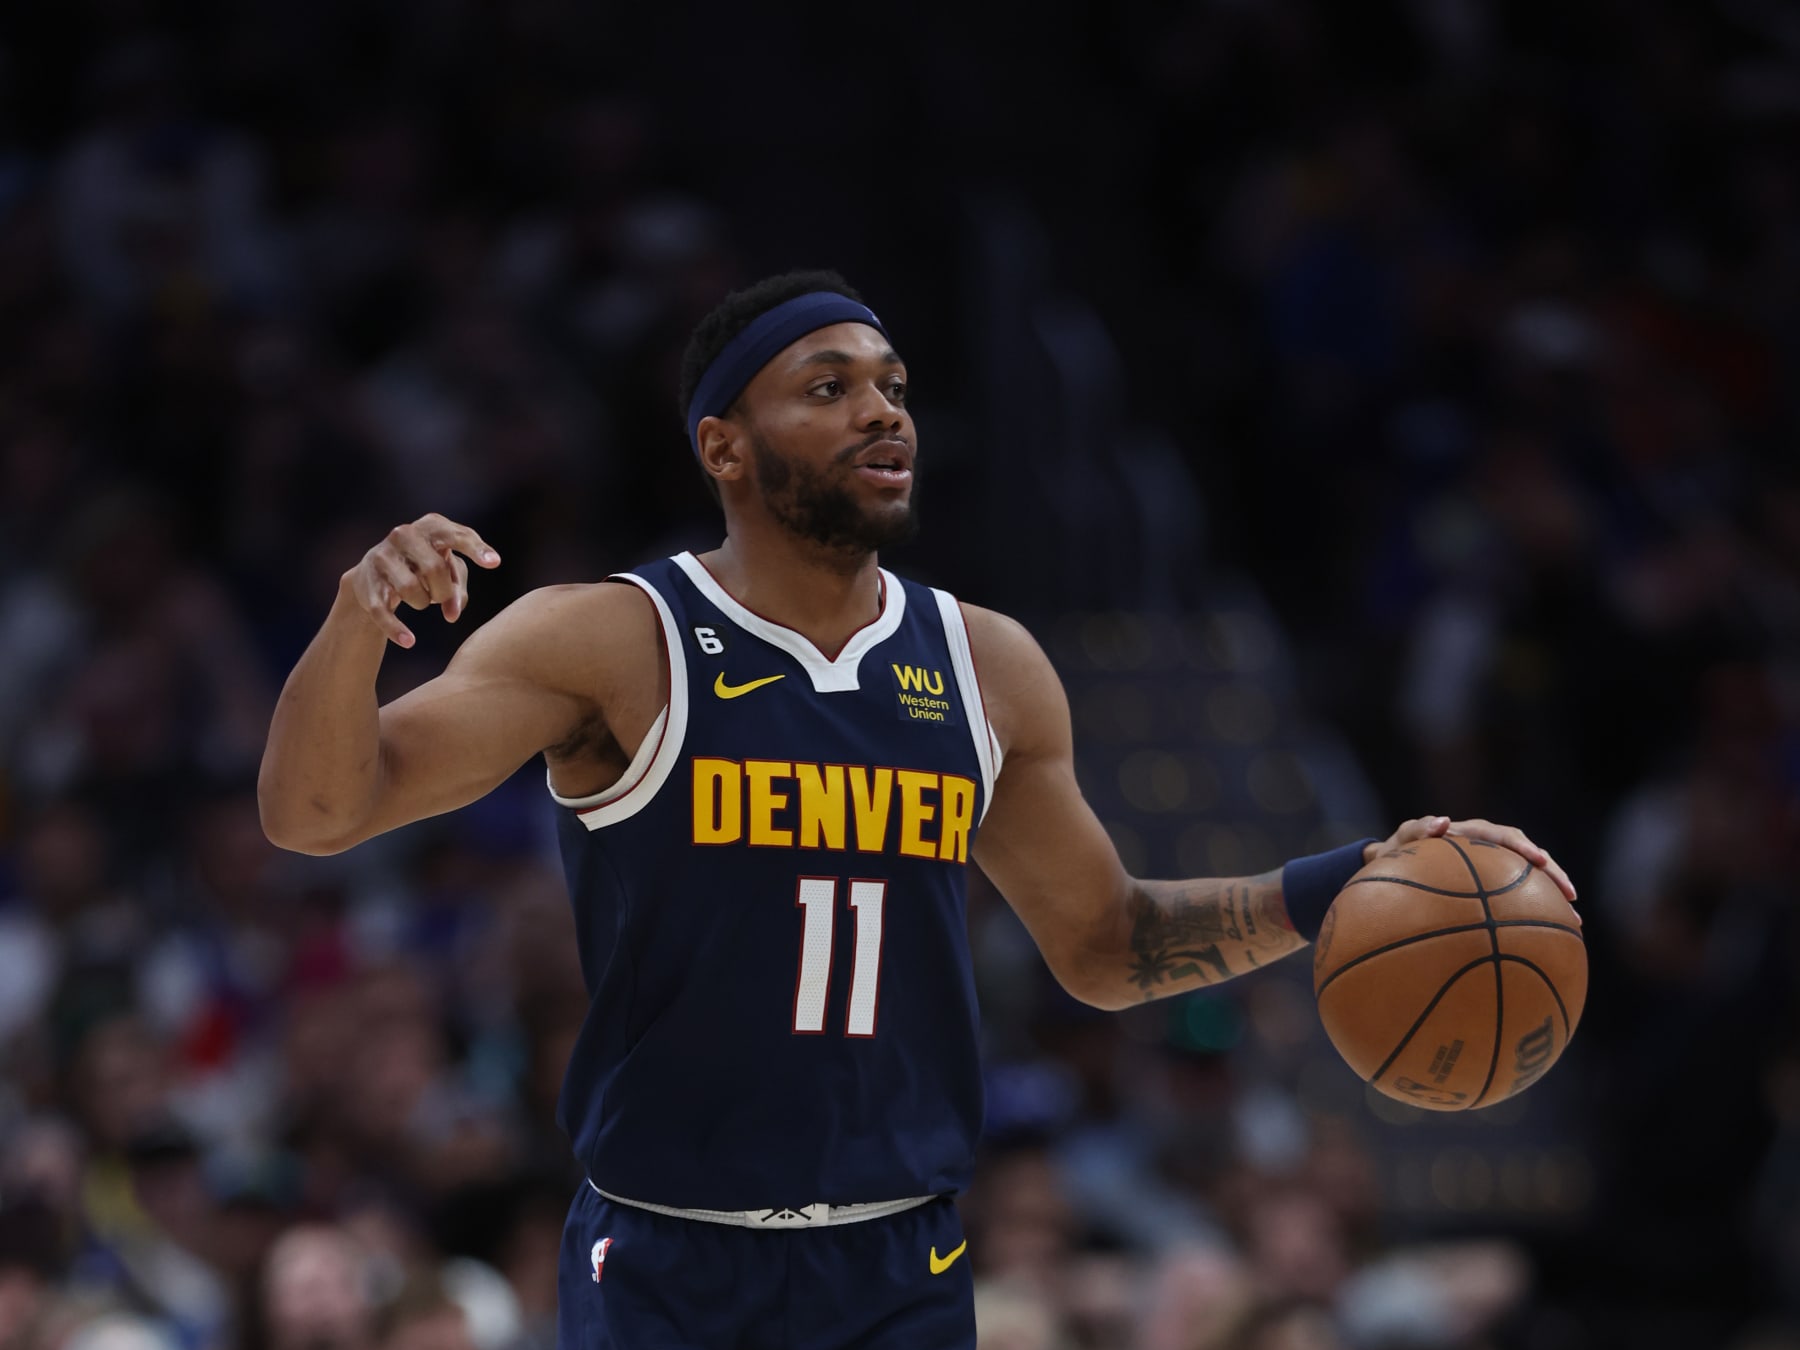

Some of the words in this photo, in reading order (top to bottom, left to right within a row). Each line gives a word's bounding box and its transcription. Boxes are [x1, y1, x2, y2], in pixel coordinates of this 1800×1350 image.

[694, 627, 724, 655] 6
[891, 663, 944, 695] WU
[898, 692, 949, 711] Western
[909, 706, 944, 722] Union
[691, 756, 976, 864] DENVER
[792, 876, 888, 1039] 11
